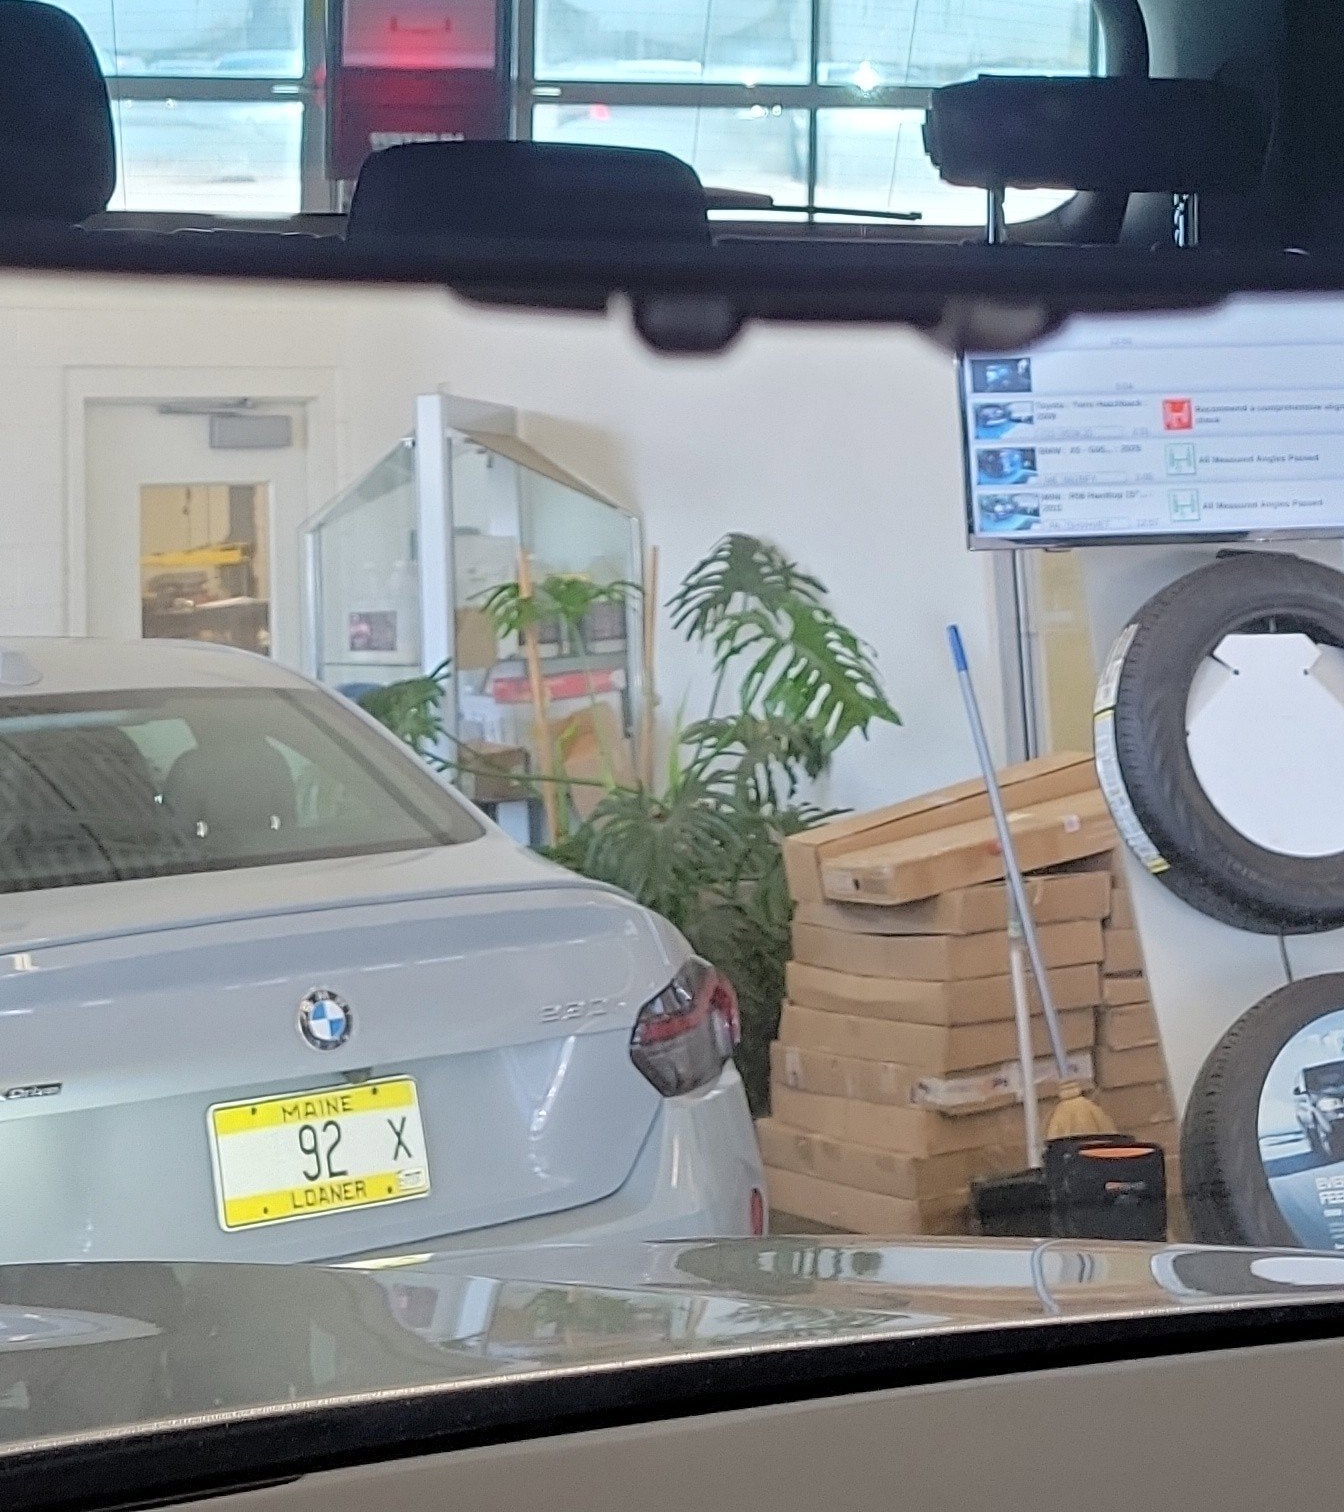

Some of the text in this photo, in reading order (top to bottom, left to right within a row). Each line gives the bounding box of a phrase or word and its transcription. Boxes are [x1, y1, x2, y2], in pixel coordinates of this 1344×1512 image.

[282, 1095, 355, 1122] MAINE
[298, 1116, 412, 1181] 92 X
[292, 1180, 367, 1209] LOANER
